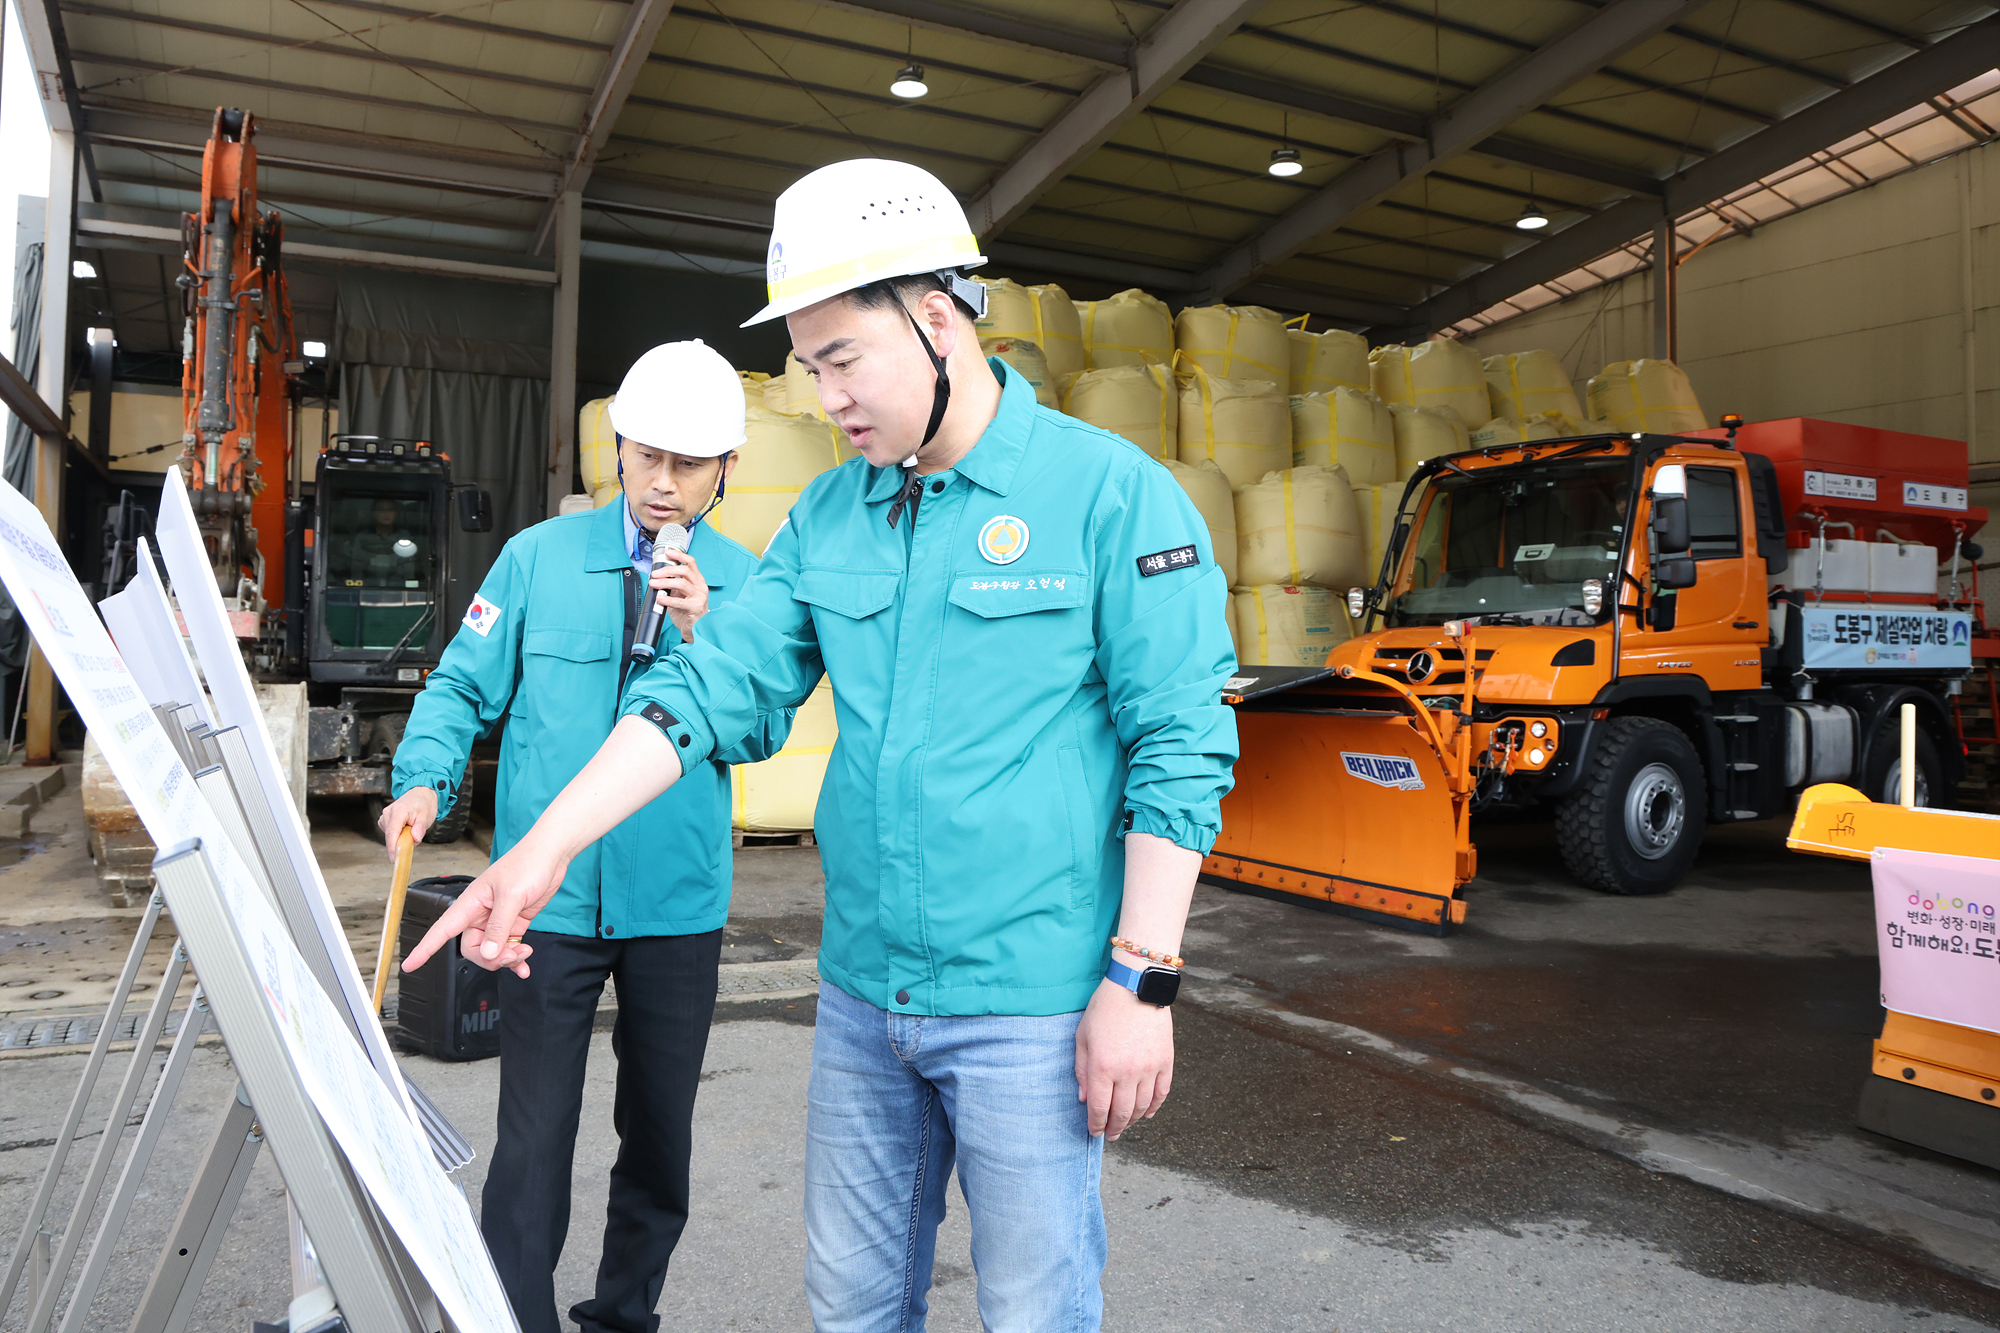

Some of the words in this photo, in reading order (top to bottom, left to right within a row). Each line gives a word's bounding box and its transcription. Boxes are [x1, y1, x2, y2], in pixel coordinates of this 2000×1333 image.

[1146, 555, 1168, 570] 서울
[1170, 549, 1194, 564] 도봉구
[1834, 614, 1873, 644] 도봉구
[1875, 615, 1922, 645] 제설작업
[1924, 616, 1948, 645] 차량
[1345, 756, 1415, 782] BEILHACK
[1908, 890, 1995, 920] dobong
[1907, 911, 1996, 935] 변화·성장·미래
[1887, 922, 1969, 954] 함께해요!
[1972, 938, 2000, 964] 도
